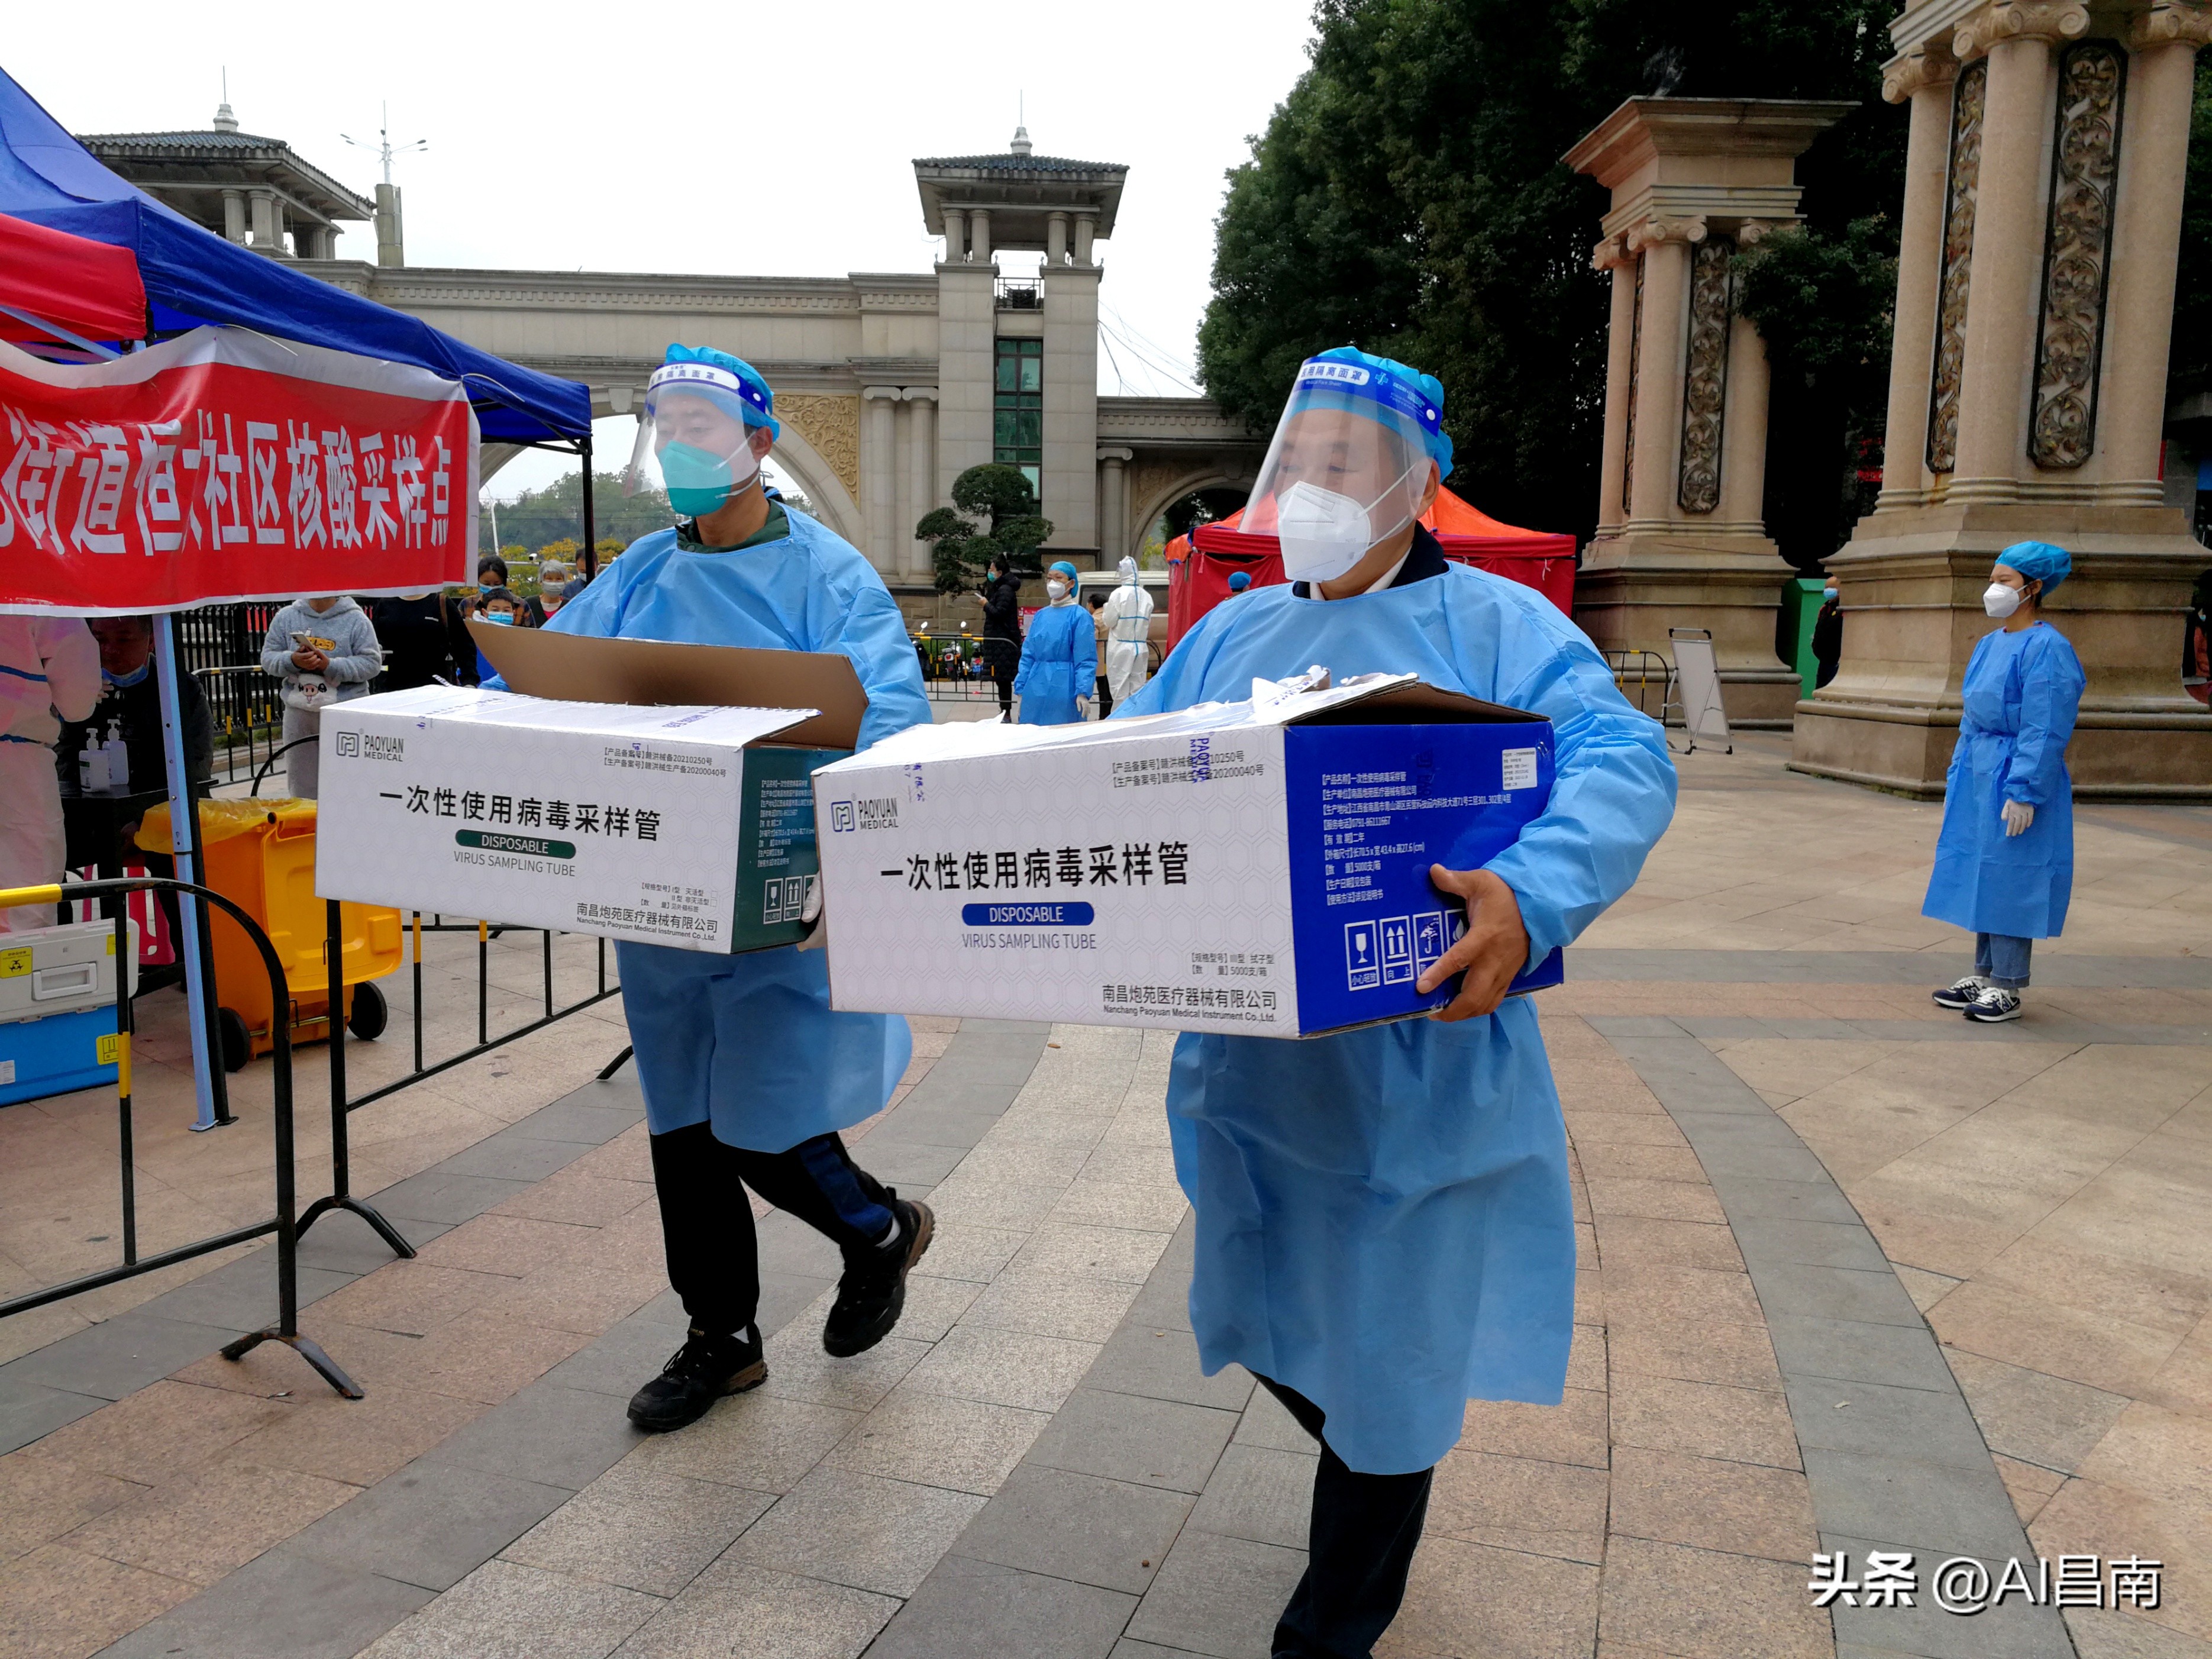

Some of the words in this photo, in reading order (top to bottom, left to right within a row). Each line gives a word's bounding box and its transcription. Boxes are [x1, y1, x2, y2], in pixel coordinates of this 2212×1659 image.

[0, 402, 451, 556] 街道恒社区核酸采样点
[364, 735, 403, 753] PAOYUAN
[364, 751, 403, 761] MEDICAL
[379, 785, 661, 841] 一次性使用病毒采样管
[858, 798, 897, 819] PAOYUAN
[860, 818, 899, 830] MEDICAL
[482, 834, 548, 854] DISPOSABLE
[454, 851, 485, 865] VIRUS
[487, 856, 543, 873] SAMPLING
[547, 862, 576, 877] TUBE
[881, 841, 1187, 890] 一次性使用病毒采样管
[577, 902, 718, 933] 南昌炮苑医疗器械有限公司
[990, 906, 1064, 923] DISPOSABLE
[577, 916, 606, 928] Nanchang
[608, 921, 632, 931] Paoyuan
[634, 925, 657, 933] Medical
[658, 928, 690, 937] Instrument
[962, 934, 996, 948] VIRUS
[999, 934, 1060, 949] SAMPLING
[1063, 934, 1096, 948] TUBE
[1103, 985, 1276, 1010] 南昌炮苑医疗器械有限公司
[1103, 1005, 1138, 1016] Nanchang
[1139, 1007, 1170, 1019] Paoyuan
[1172, 1008, 1200, 1018] Medical
[1202, 1009, 1244, 1021] Instrument
